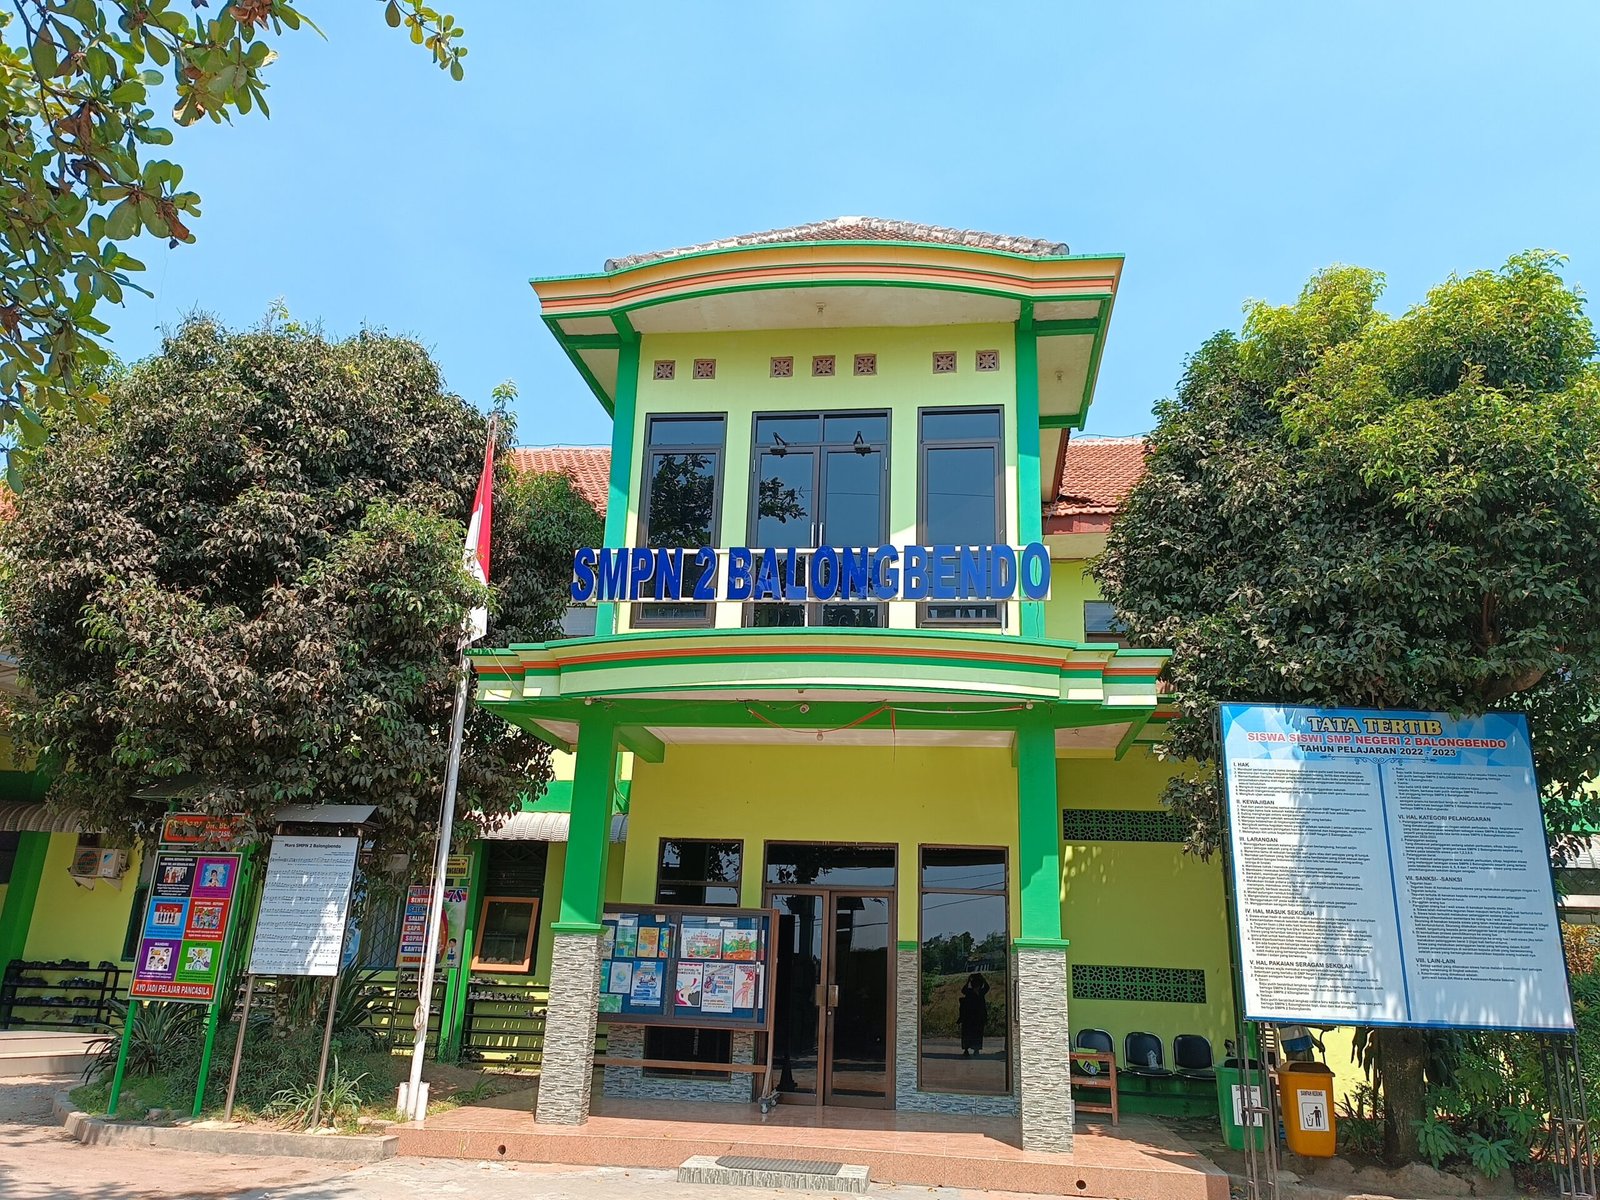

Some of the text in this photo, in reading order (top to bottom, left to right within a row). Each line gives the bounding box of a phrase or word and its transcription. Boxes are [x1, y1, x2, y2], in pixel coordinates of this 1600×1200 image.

[571, 542, 1051, 601] SMPN 2 BALONGBENDO
[1308, 716, 1443, 736] TATA TERTIB
[1247, 732, 1507, 749] SISWA SISWI SMP NEGERI 2 BALONGBENDO
[1300, 744, 1335, 753] TAHUN
[1337, 745, 1397, 755] PELAJARAN
[1400, 747, 1424, 756] 2022
[1432, 748, 1457, 757] 2023
[448, 889, 463, 902] 7S
[135, 983, 210, 996] AYO JADI PELAJAR PANCASILA
